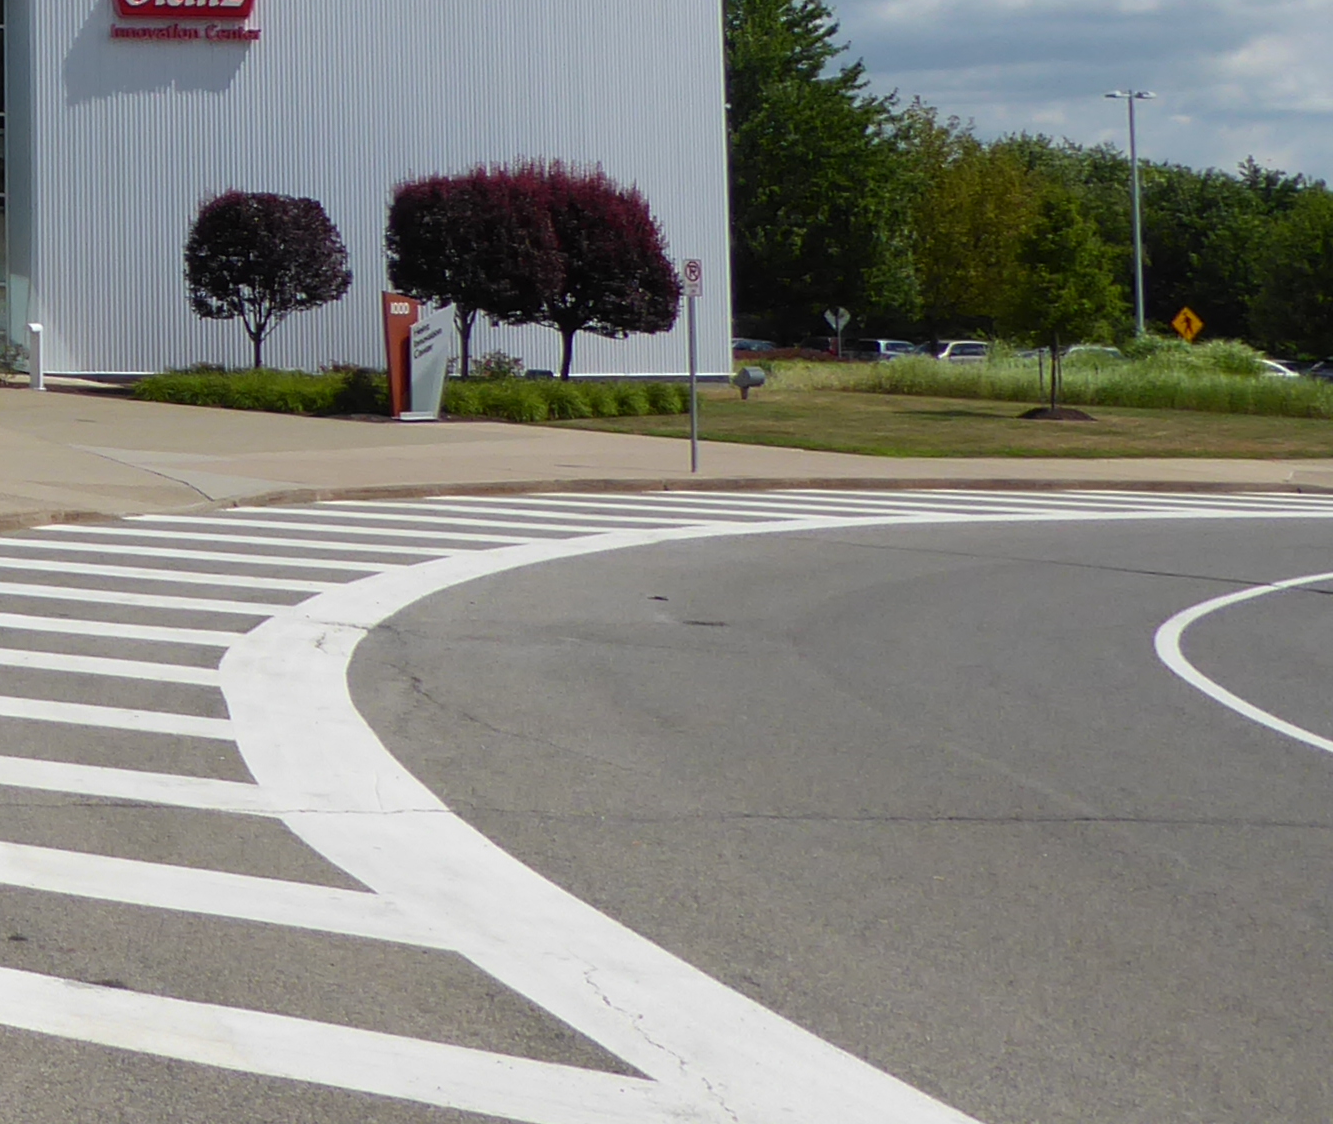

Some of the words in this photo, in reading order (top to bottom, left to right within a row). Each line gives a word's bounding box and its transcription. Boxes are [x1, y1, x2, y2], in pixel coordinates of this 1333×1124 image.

[110, 24, 199, 41] Innovation
[205, 24, 262, 41] Center
[390, 302, 410, 315] 1000
